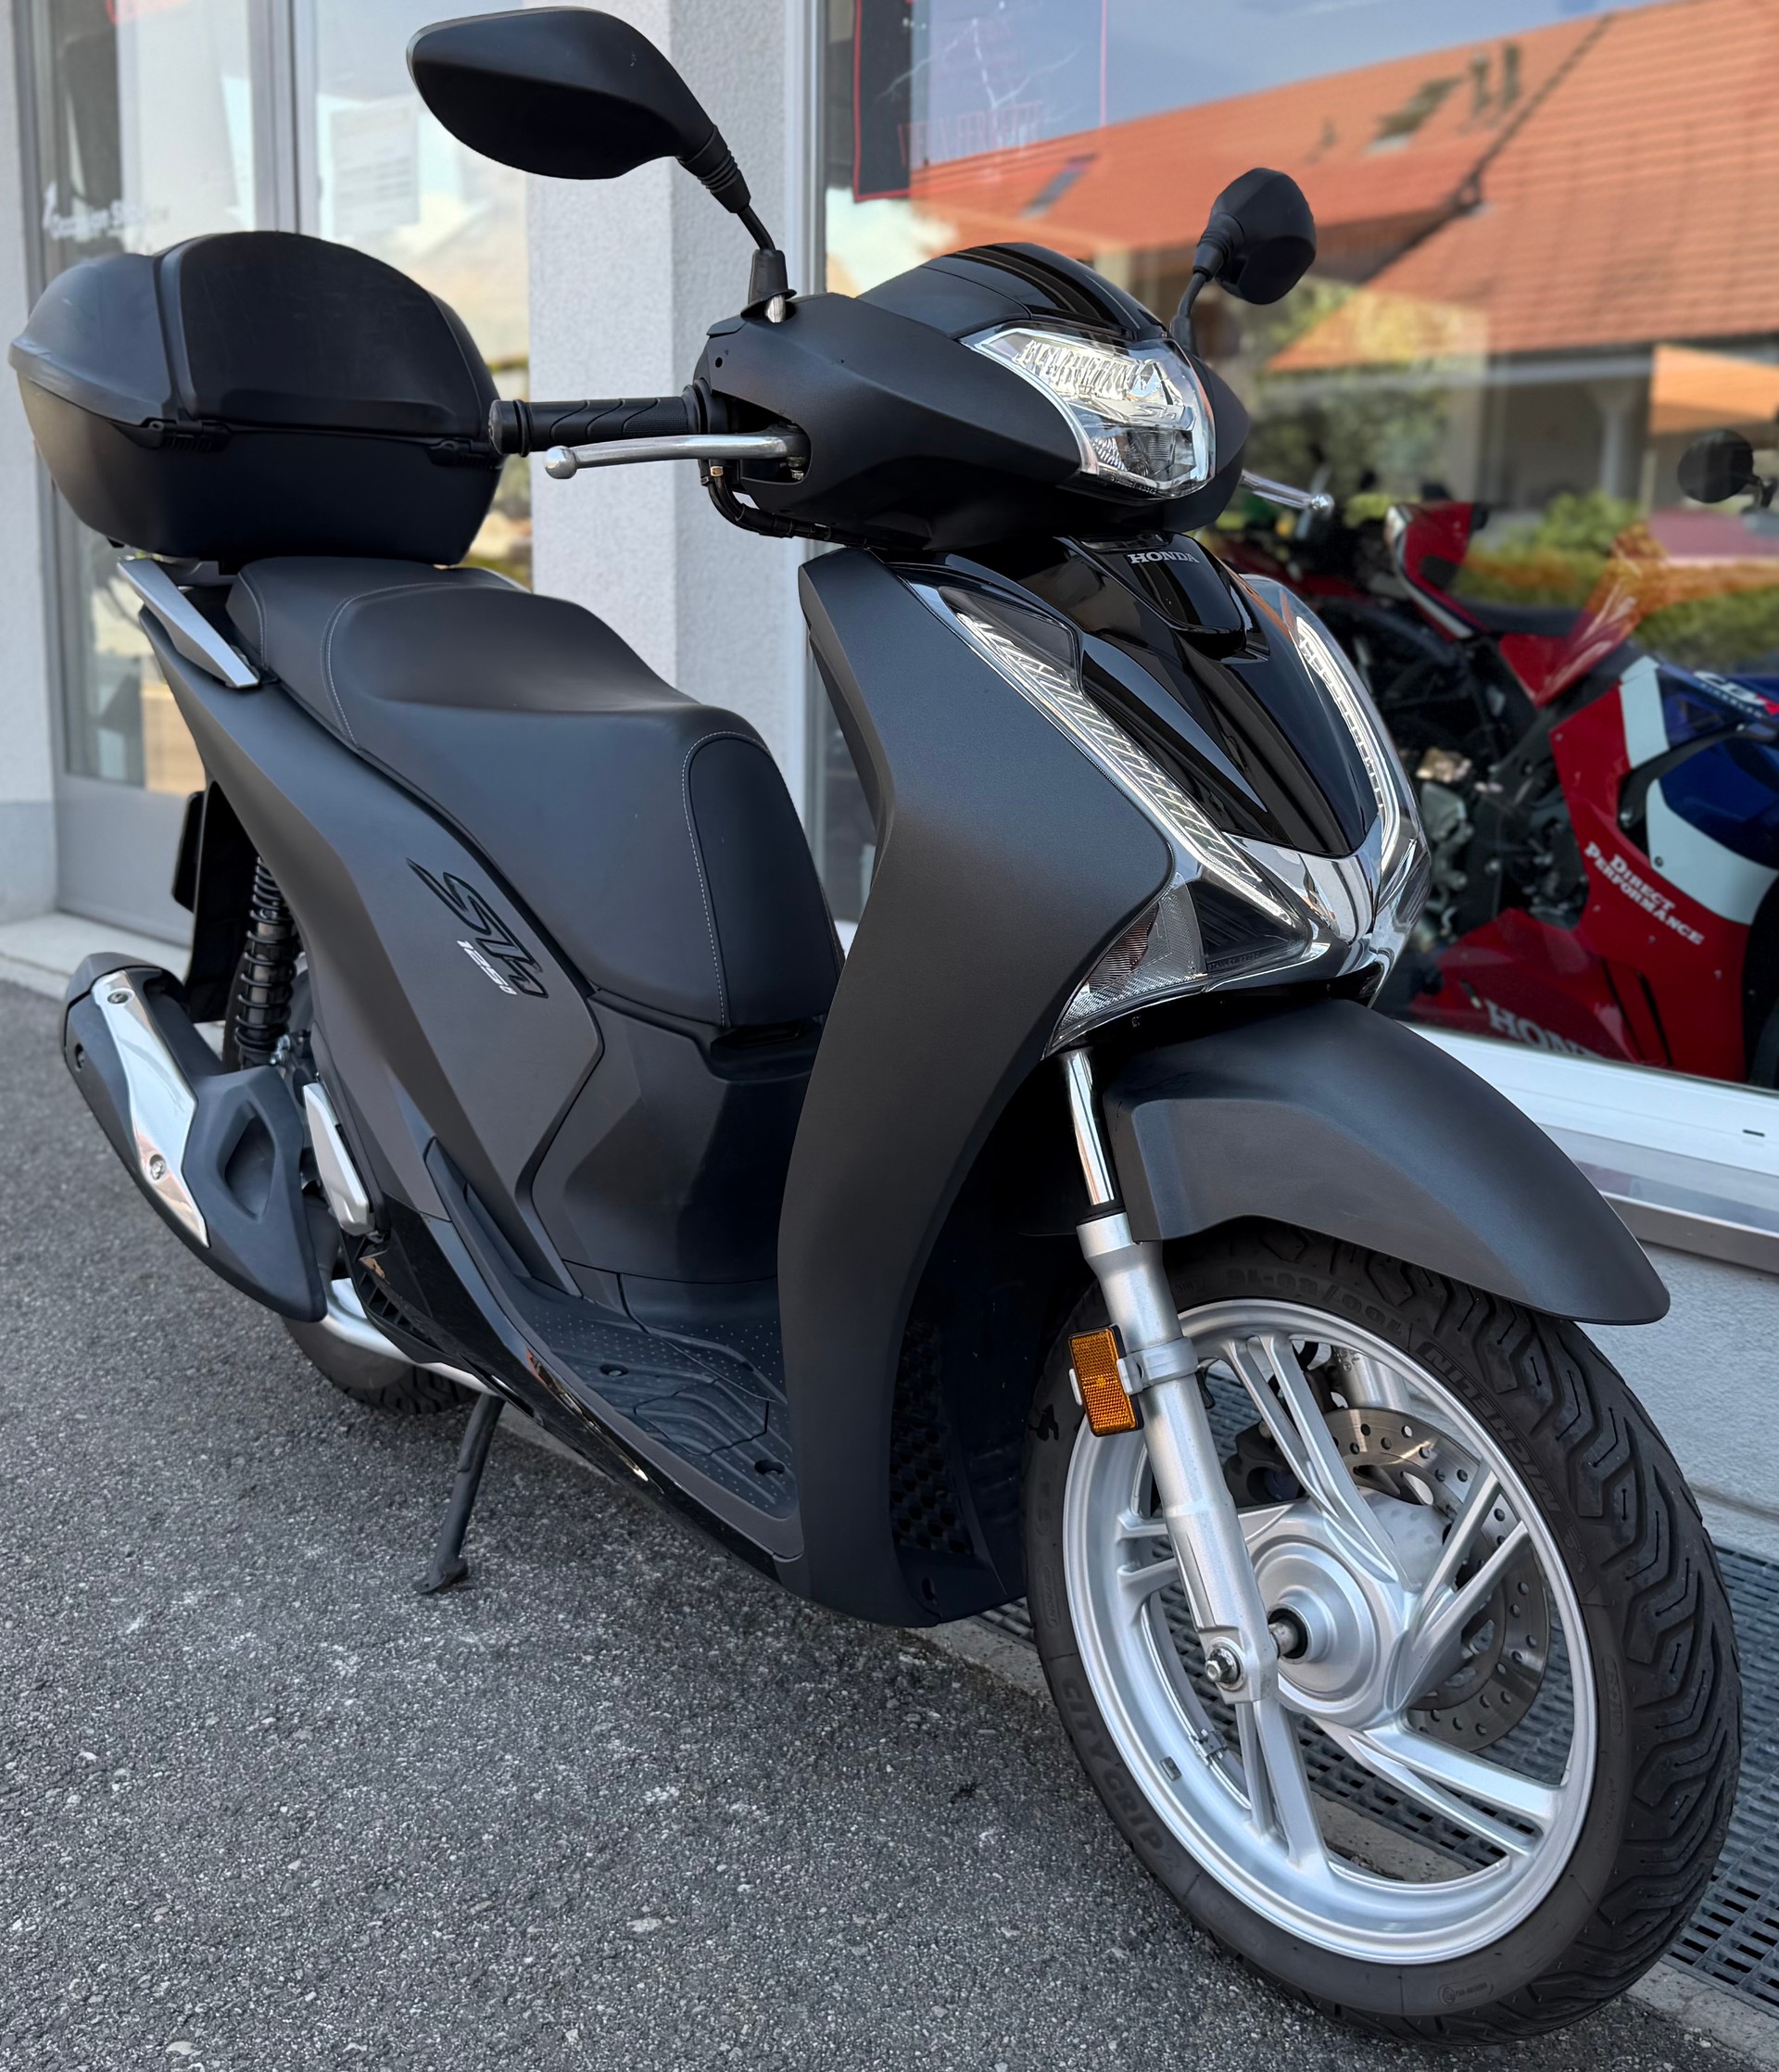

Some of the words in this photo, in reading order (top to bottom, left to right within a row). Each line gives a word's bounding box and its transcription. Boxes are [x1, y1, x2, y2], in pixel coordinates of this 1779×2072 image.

[1127, 551, 1201, 564] HONDA
[1583, 840, 1705, 945] PERFORMANCE
[1609, 853, 1676, 911] DIRECT
[1421, 1346, 1564, 1512] MICHELIN
[1061, 1677, 1112, 1760] CITY
[1102, 1767, 1165, 1851] GRIP
